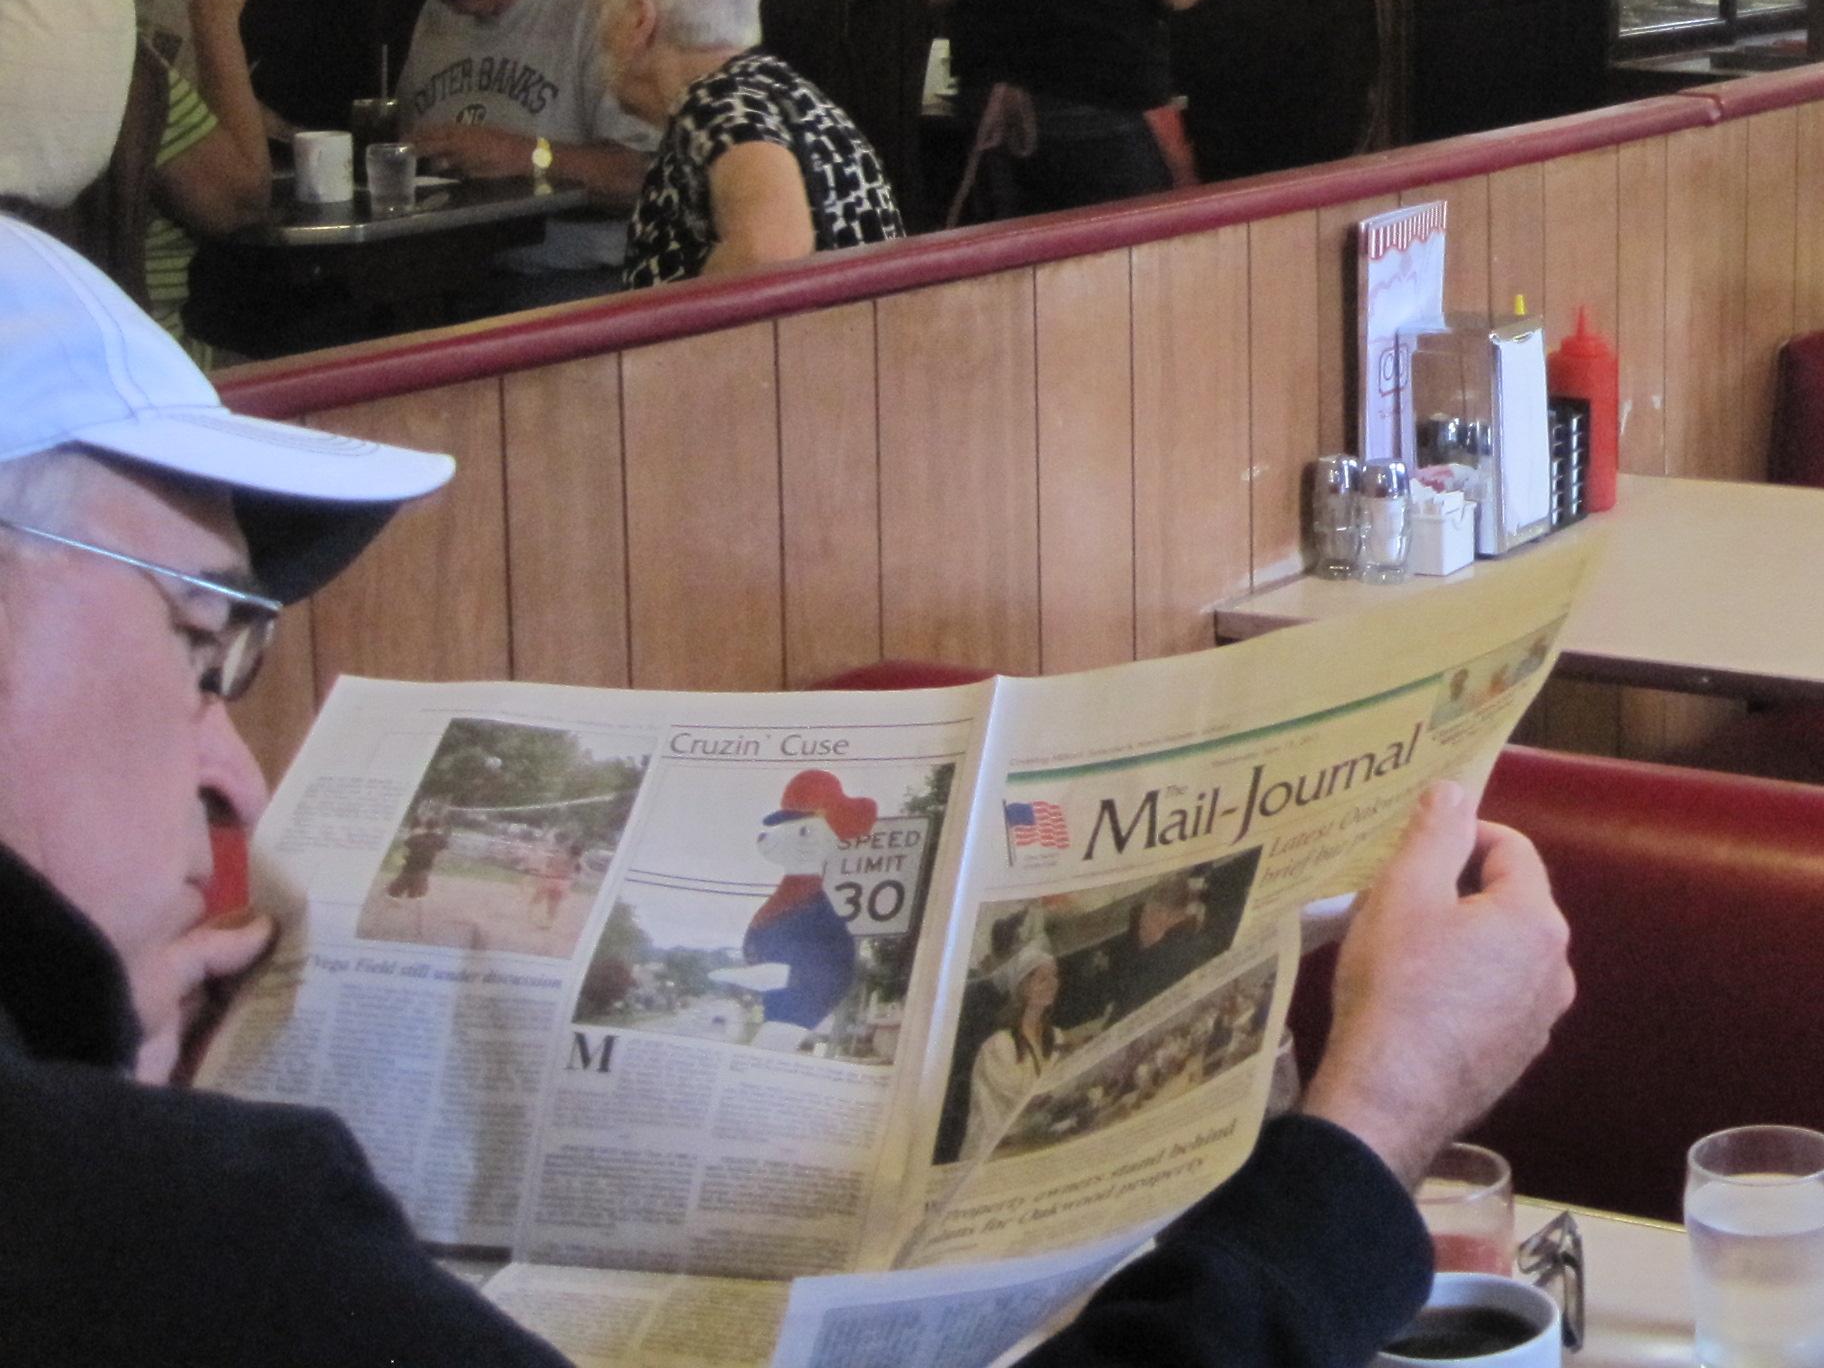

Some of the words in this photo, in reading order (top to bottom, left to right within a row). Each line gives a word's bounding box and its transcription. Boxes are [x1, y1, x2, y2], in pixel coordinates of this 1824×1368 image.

[414, 56, 473, 114] OUTER
[477, 55, 560, 115] BANKS
[780, 733, 850, 757] Cuse
[1081, 721, 1424, 861] Mail-Journal
[840, 854, 909, 876] LIMIT
[833, 879, 906, 923] 30
